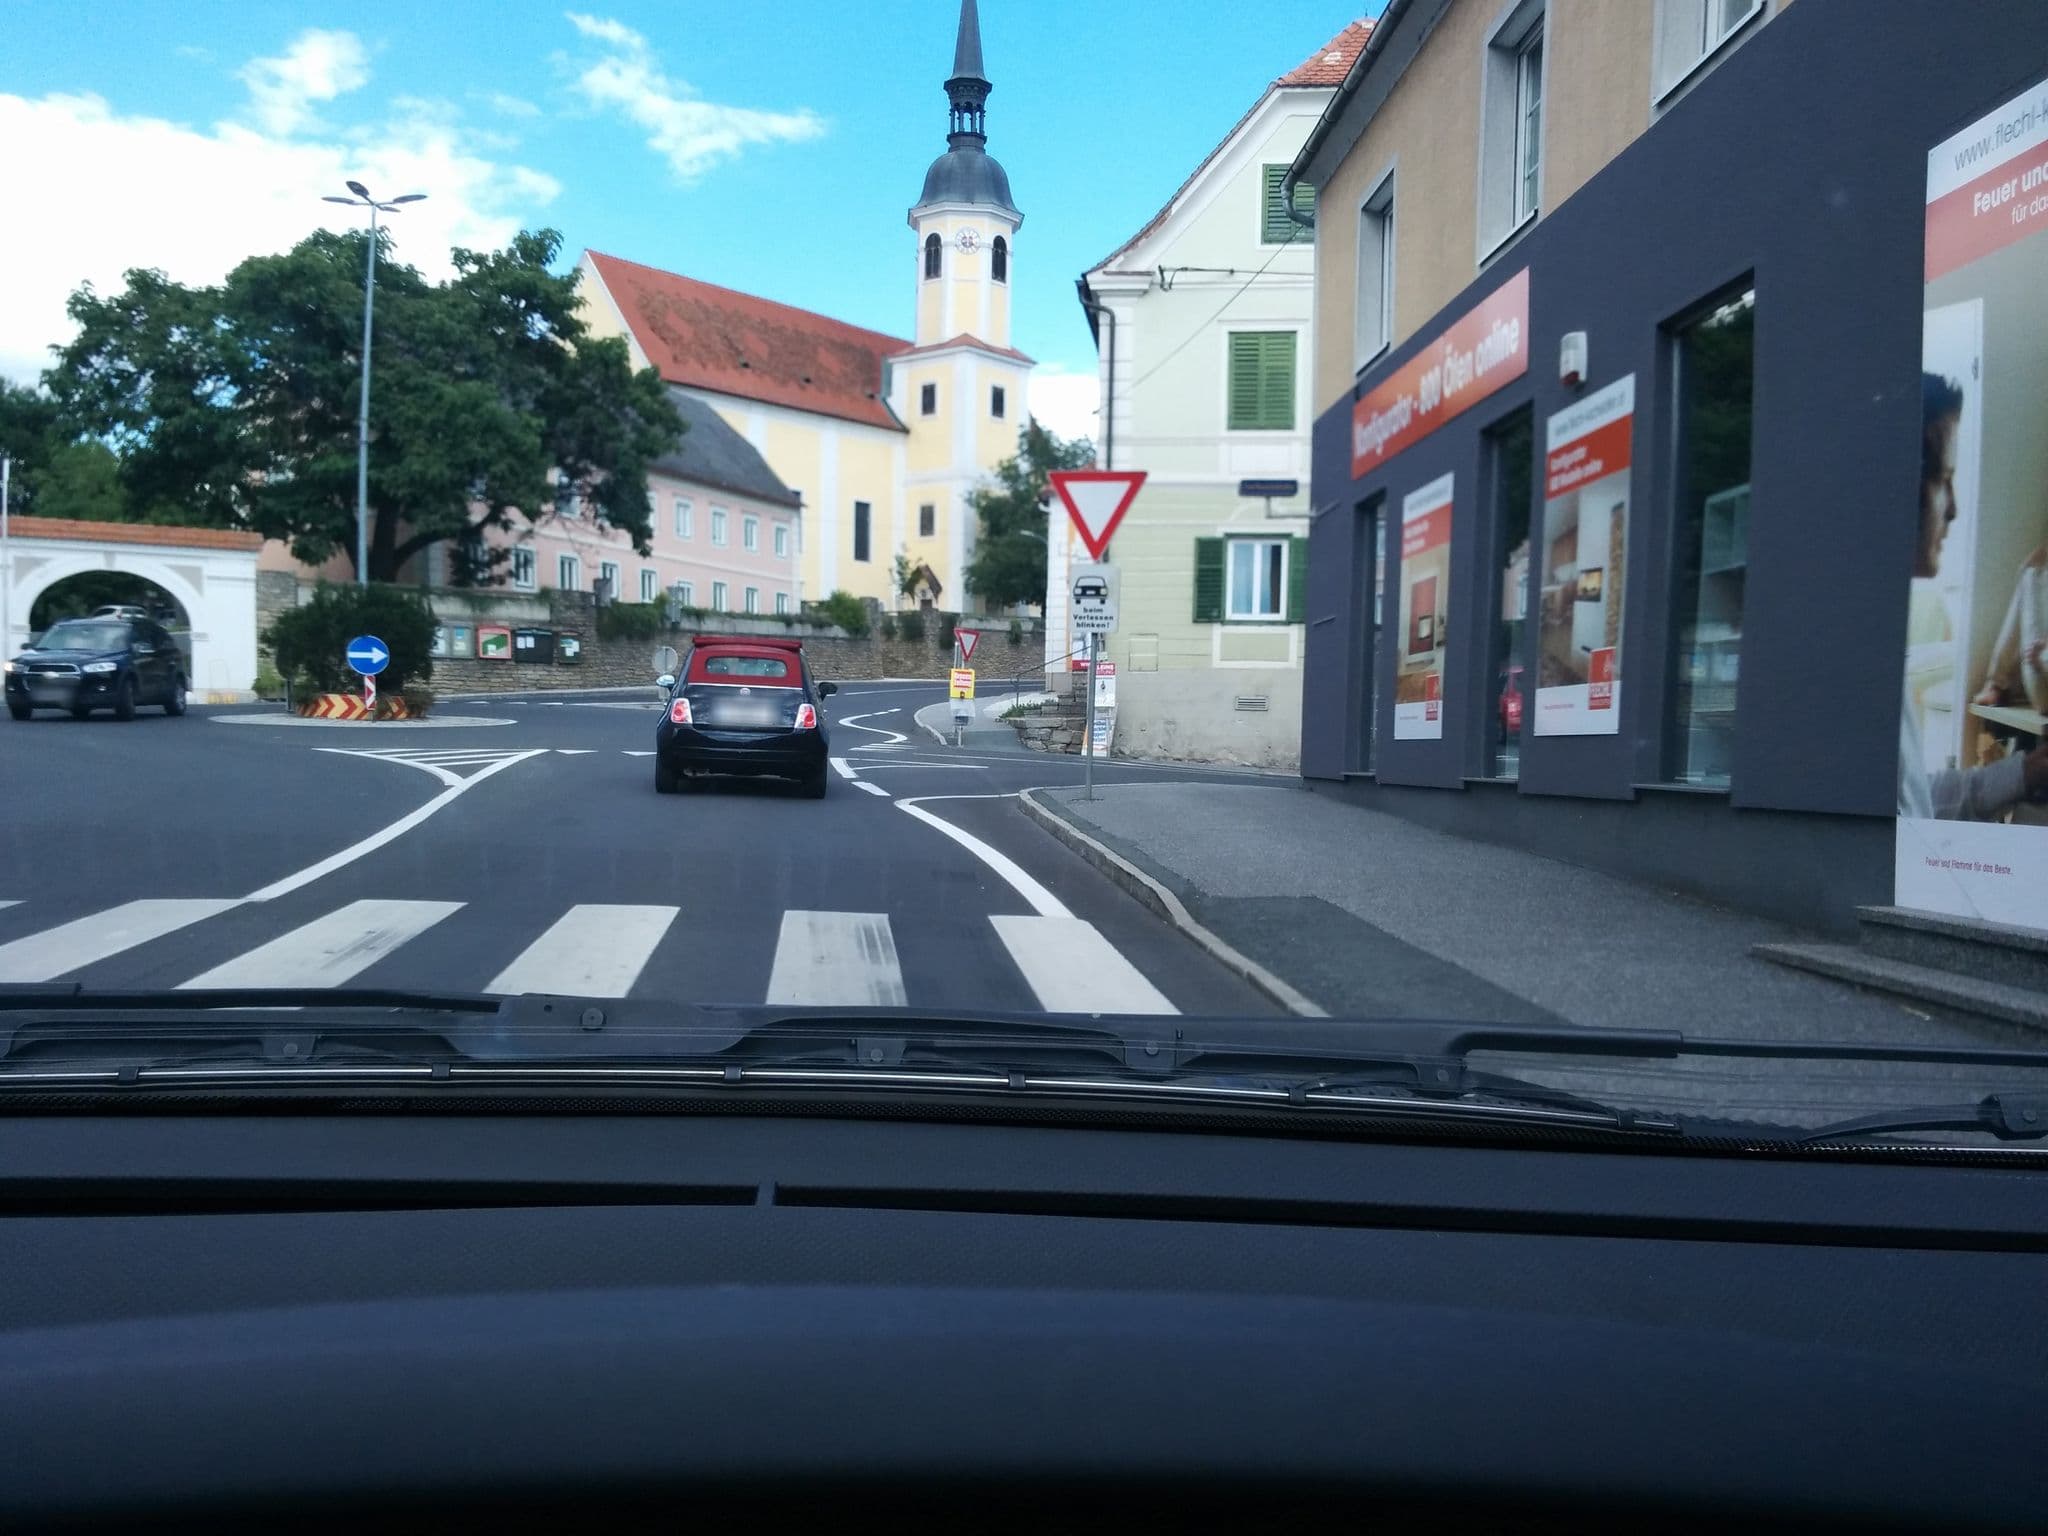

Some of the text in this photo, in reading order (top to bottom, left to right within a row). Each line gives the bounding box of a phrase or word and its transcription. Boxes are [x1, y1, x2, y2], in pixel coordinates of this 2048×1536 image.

[1973, 178, 2018, 217] Feuer
[2011, 204, 2028, 225] für
[1442, 343, 1474, 398] Öfen
[1474, 318, 1520, 377] online
